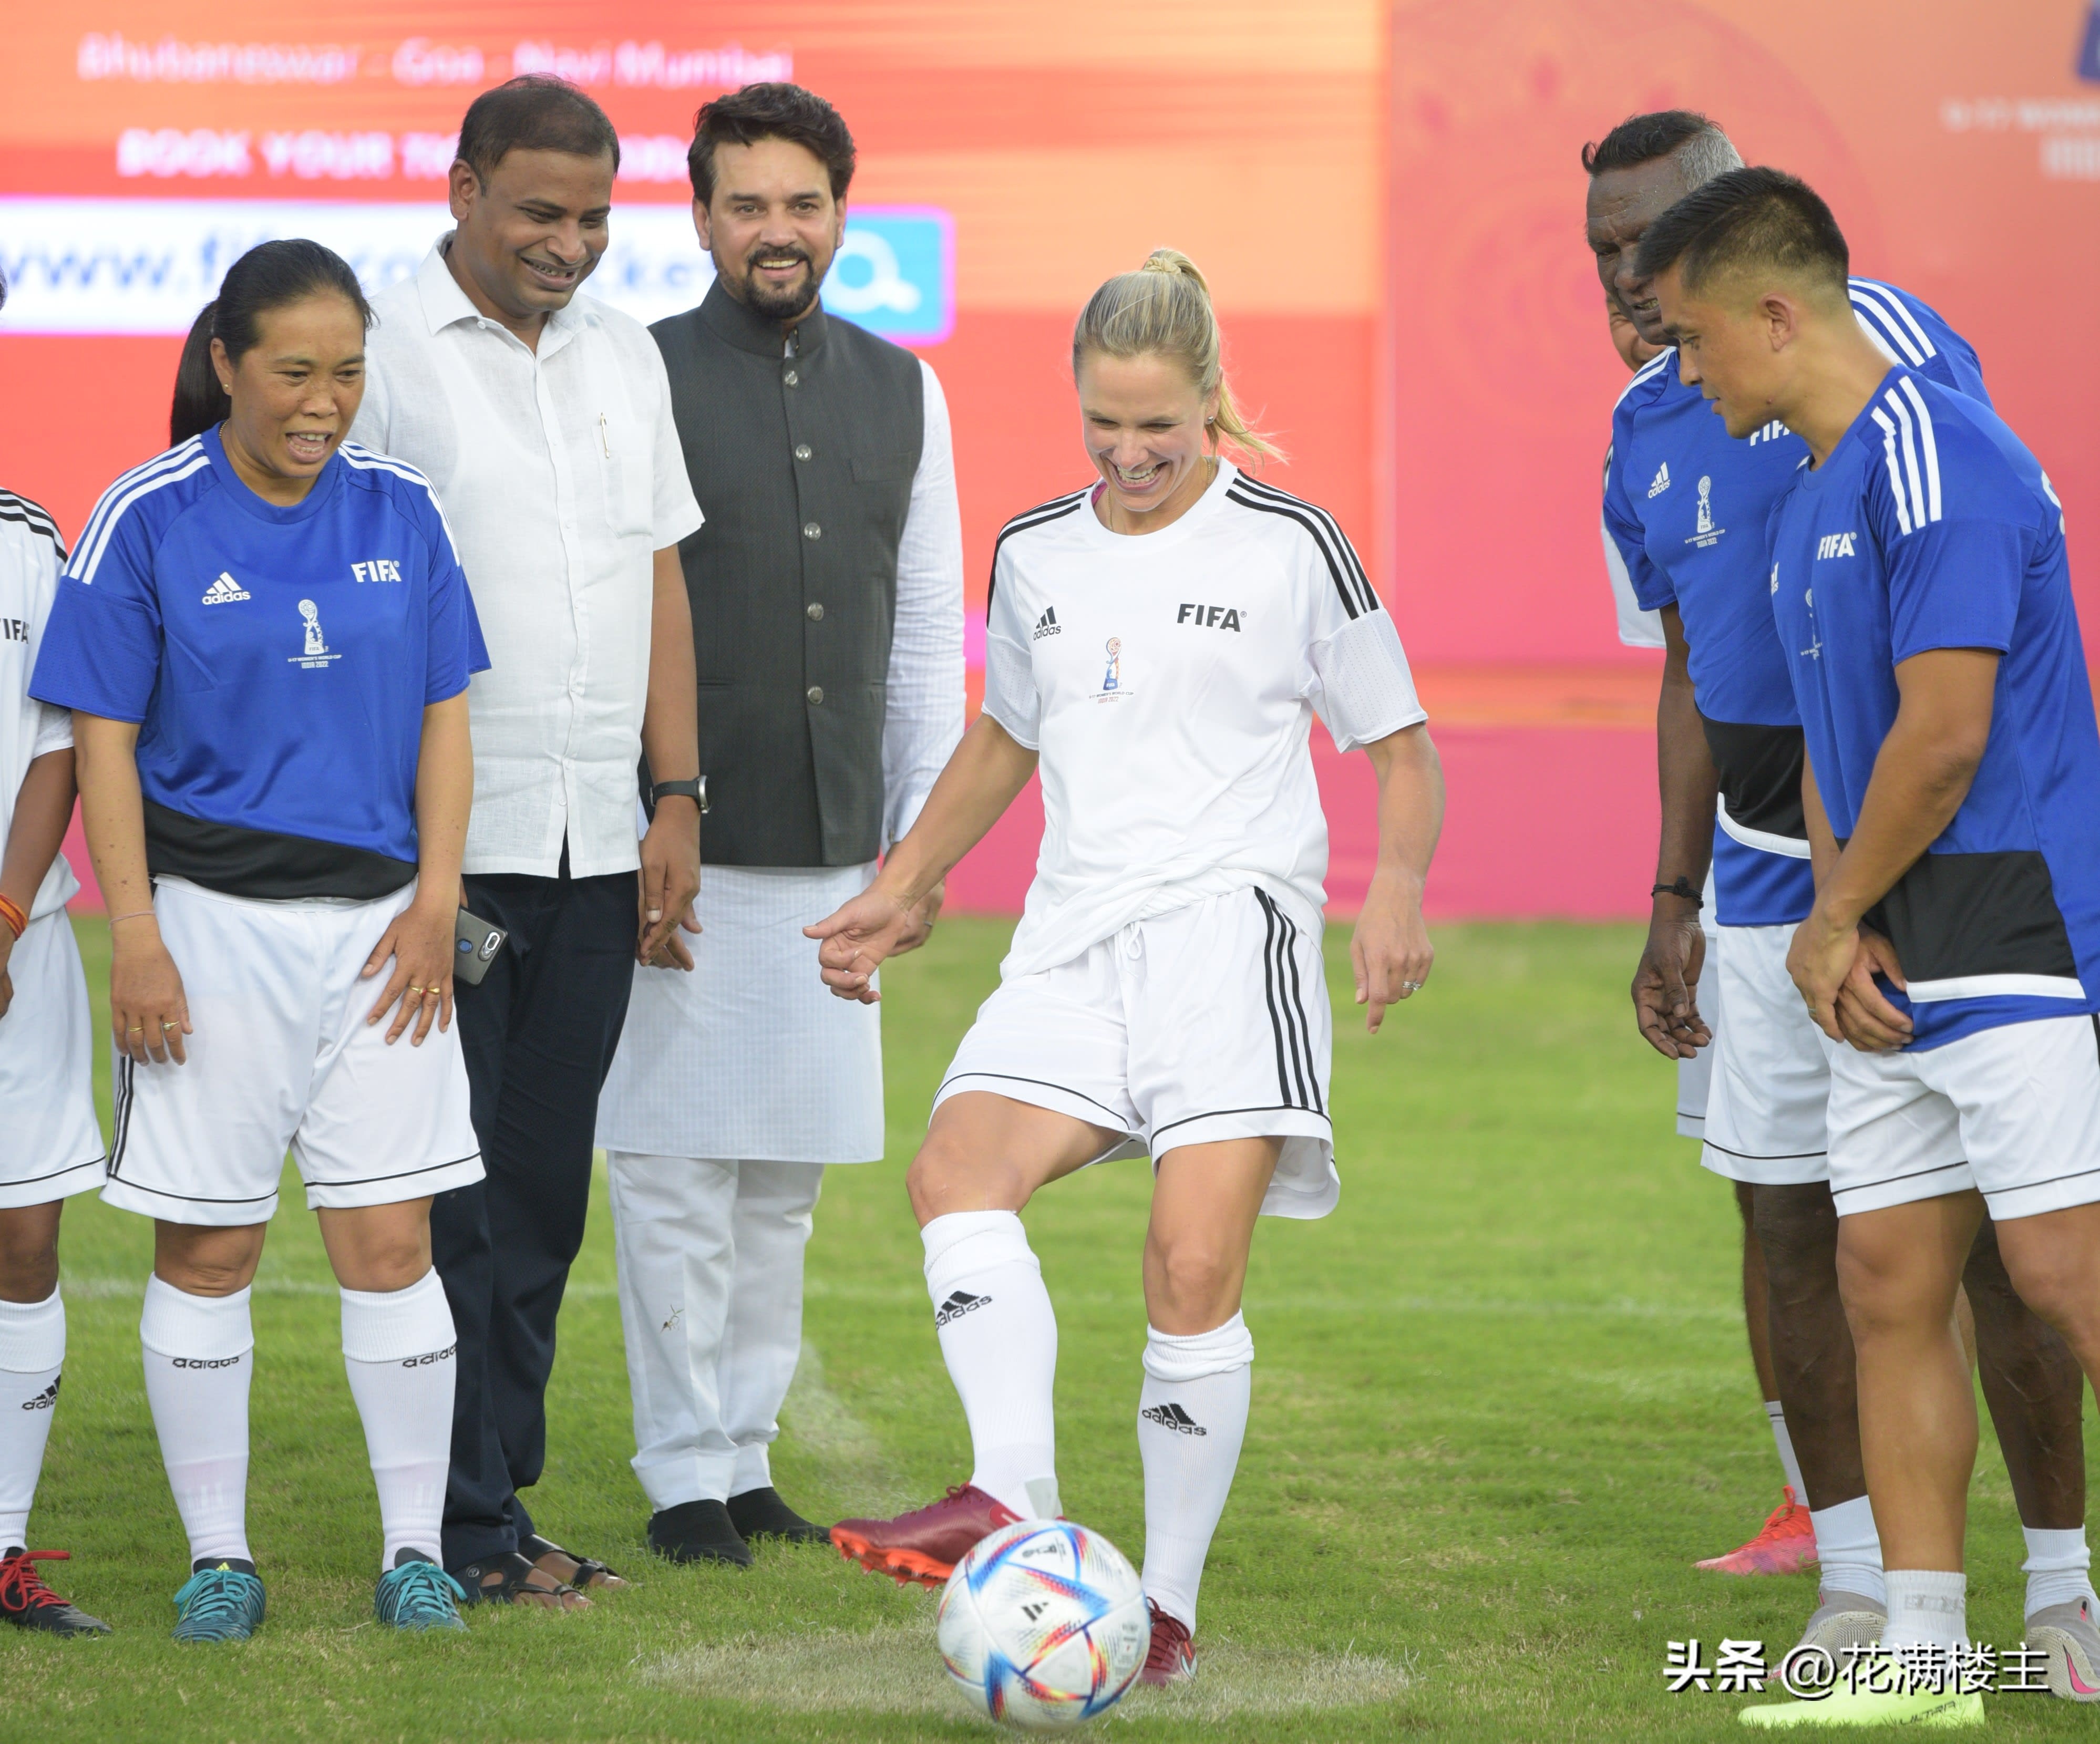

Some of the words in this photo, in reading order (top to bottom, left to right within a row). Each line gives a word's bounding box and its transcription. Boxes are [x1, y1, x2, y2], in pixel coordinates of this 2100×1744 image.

[202, 591, 251, 605] adidas
[1033, 625, 1062, 641] adidas
[1142, 1409, 1207, 1436] adidas
